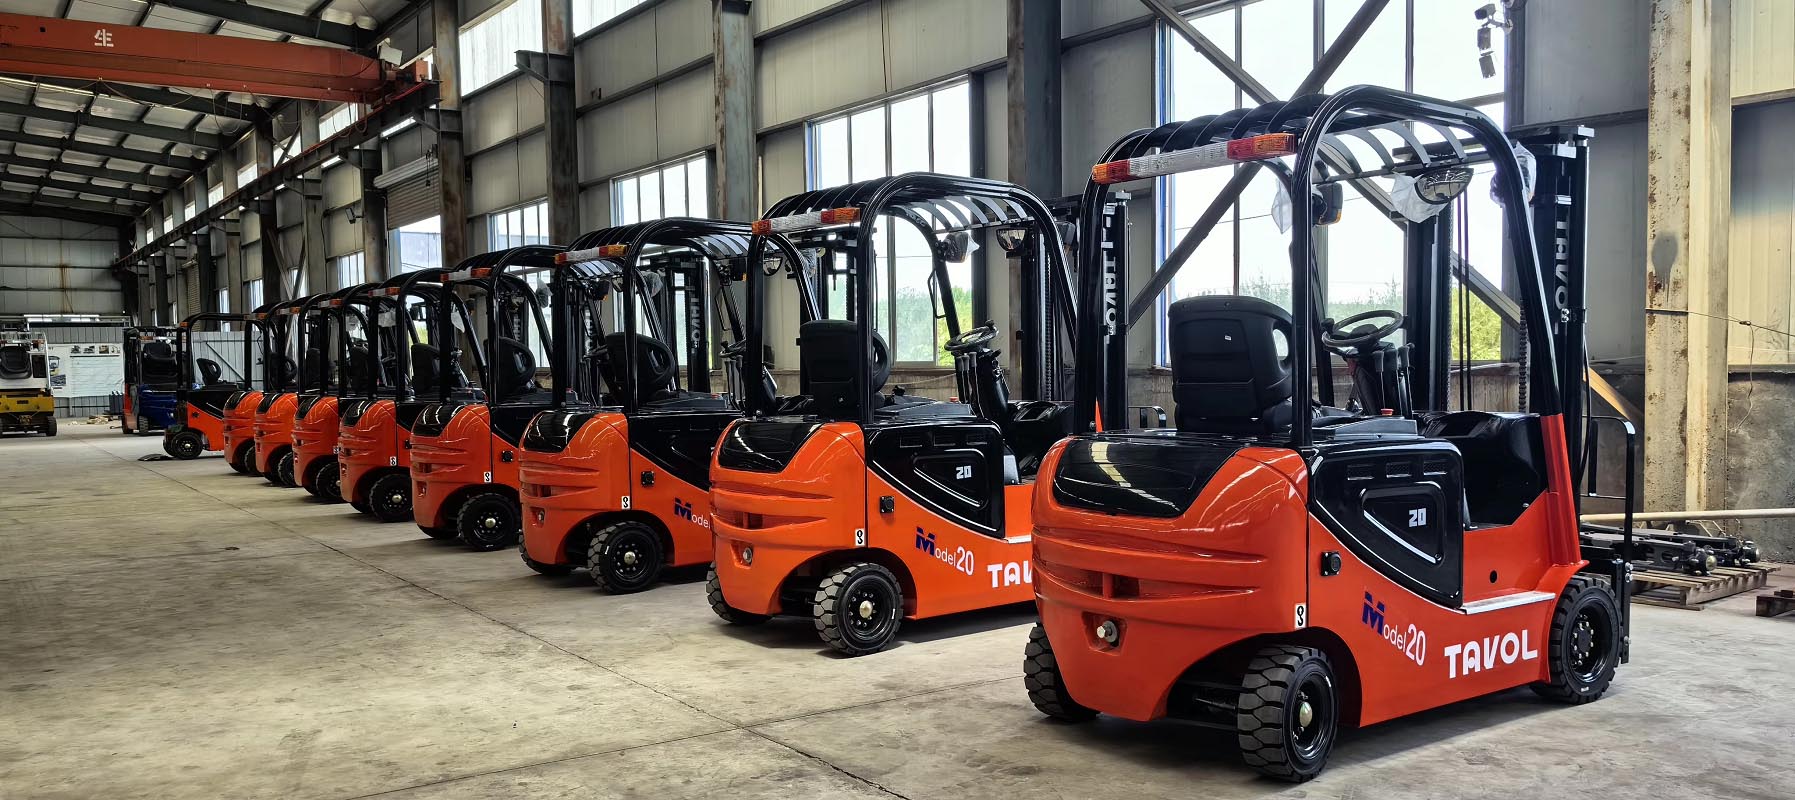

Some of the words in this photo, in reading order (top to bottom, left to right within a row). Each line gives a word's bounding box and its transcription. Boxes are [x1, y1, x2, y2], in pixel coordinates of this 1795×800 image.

[94, 29, 114, 47] 生
[1555, 215, 1569, 334] TAVO
[690, 297, 700, 353] TAVO
[1105, 256, 1117, 344] TAVO
[956, 465, 972, 480] 20
[1408, 508, 1427, 527] 20
[1444, 629, 1538, 679] TAVOL
